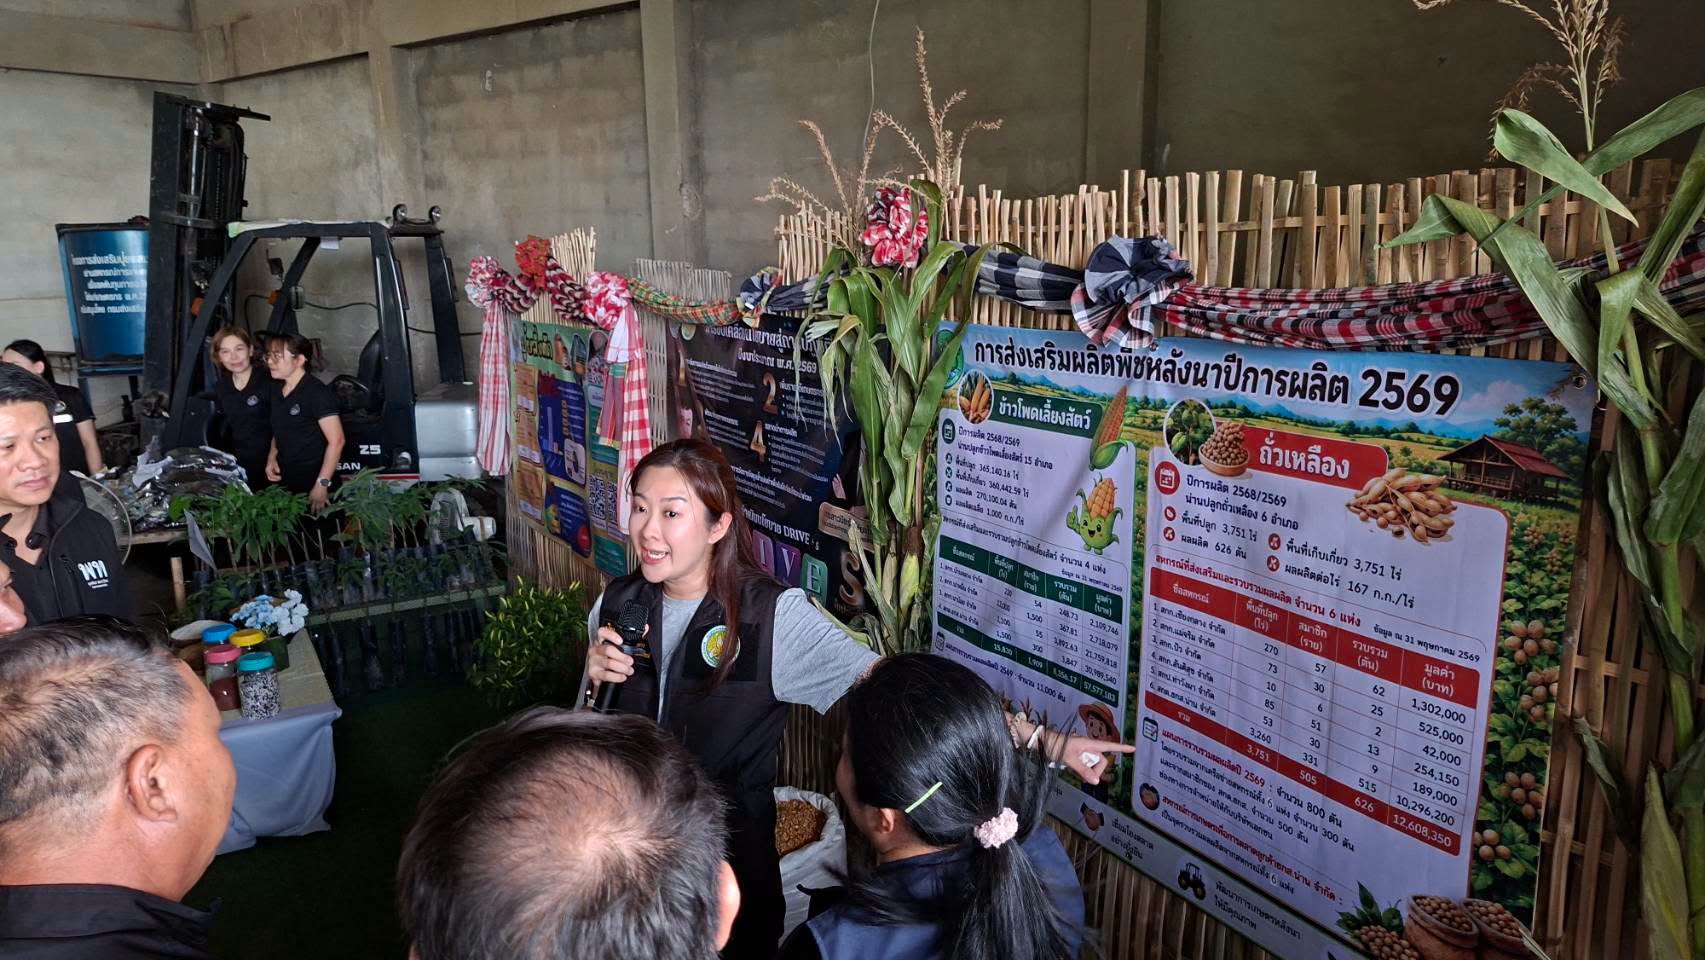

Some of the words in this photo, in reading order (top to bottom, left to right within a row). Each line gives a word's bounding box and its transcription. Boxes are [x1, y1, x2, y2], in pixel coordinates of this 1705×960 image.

[1358, 369, 1460, 416] 2569
[999, 395, 1092, 430] ข้าวโพดเลี้ยงสัตว์
[987, 433, 1020, 448] 2568/2569
[1259, 432, 1350, 479] ถั่วเหลือง
[336, 462, 361, 470] SAN
[1024, 456, 1032, 465] 15
[1186, 474, 1229, 494] ปีการผลิต
[1232, 485, 1287, 508] 2568/2569
[1182, 510, 1216, 532] พื้นที่ปลูก
[1222, 524, 1246, 539] 3,751
[1249, 530, 1258, 542] ไร่
[1186, 493, 1258, 520] น่านปลูกถั่วเหลือง
[1261, 512, 1268, 522] 6
[1271, 513, 1299, 530] อำเภอ
[784, 526, 810, 545] DRIVE
[1181, 534, 1208, 548] ผลผลิต
[1214, 544, 1232, 555] 626
[1235, 547, 1246, 560] ตัน
[1085, 561, 1090, 569] 4
[1286, 538, 1348, 566] พื้นที่เก็บเกี่ยว
[1354, 559, 1385, 577] 3,751
[1390, 566, 1402, 581] ไร่
[806, 562, 822, 594] E
[1173, 582, 1210, 604] ชื่อสหกรณ์
[1284, 564, 1340, 588] ผลผลิตต่อไร่
[1348, 581, 1368, 596] 167
[1373, 590, 1414, 609] ก.ก./ไร่
[1246, 600, 1278, 622] พื้นที่ปลูก
[1294, 595, 1326, 616] จำนวน
[1329, 608, 1336, 619] 6
[1340, 610, 1361, 627] แห่ง
[1298, 622, 1328, 639] สมาชิก
[1300, 635, 1323, 654] (ราย)
[1352, 639, 1388, 660] รวบรวม
[1405, 632, 1414, 644] 31
[1417, 640, 1456, 657] พฤษภาคม
[1458, 649, 1480, 663] 2569
[1208, 620, 1226, 636] จำกัด
[1264, 643, 1279, 656] 270
[1315, 663, 1326, 674] 57
[1372, 684, 1386, 698] 62
[1411, 698, 1466, 724] 1,302,000
[1358, 654, 1380, 674] (ตัน)
[1424, 662, 1455, 681] มูลค่า
[1198, 633, 1216, 649] จำกัด
[1268, 662, 1278, 674] 73
[1314, 682, 1324, 694] 30
[1370, 704, 1384, 716] 25
[1418, 722, 1464, 745] 525,000
[1422, 676, 1454, 697] (บาท)
[1184, 647, 1202, 661] จำกัด
[1266, 681, 1276, 692] 10
[1318, 703, 1324, 712] 6
[1376, 726, 1382, 736] 2
[1422, 745, 1462, 766] 42,000
[1198, 670, 1214, 683] จำกัด
[1264, 699, 1274, 710] 85
[1311, 720, 1321, 731] 51
[1368, 744, 1380, 756] 13
[1414, 763, 1460, 788] 254,150
[1198, 686, 1215, 700] จำกัด
[1263, 716, 1273, 727] 53
[1309, 738, 1320, 750] 30
[1372, 764, 1378, 774] 9
[1413, 782, 1458, 807] 189,000
[1178, 711, 1190, 722] รวม
[1248, 744, 1270, 762] 3,751
[1300, 770, 1318, 785] 505
[1354, 796, 1374, 813] 626
[1393, 814, 1451, 848] 12,608,350
[1200, 703, 1216, 717] จำกัด
[1250, 728, 1272, 744] 3,260
[1302, 752, 1318, 766] 331
[1358, 778, 1376, 793] 515
[1396, 795, 1455, 826] 10,296,200
[1244, 771, 1266, 788] 2569
[1276, 786, 1304, 808] จำนวน
[1306, 804, 1326, 819] 800
[1328, 812, 1342, 828] ตัน
[1251, 805, 1274, 826] จำนวน
[1278, 820, 1294, 836] 500
[1297, 830, 1309, 844] ตัน
[1267, 798, 1274, 809] 6
[1276, 805, 1290, 818] แห่ง
[1294, 814, 1318, 833] จำนวน
[1322, 829, 1339, 844] 300
[1342, 837, 1354, 852] ตัน
[1271, 874, 1277, 885] 6
